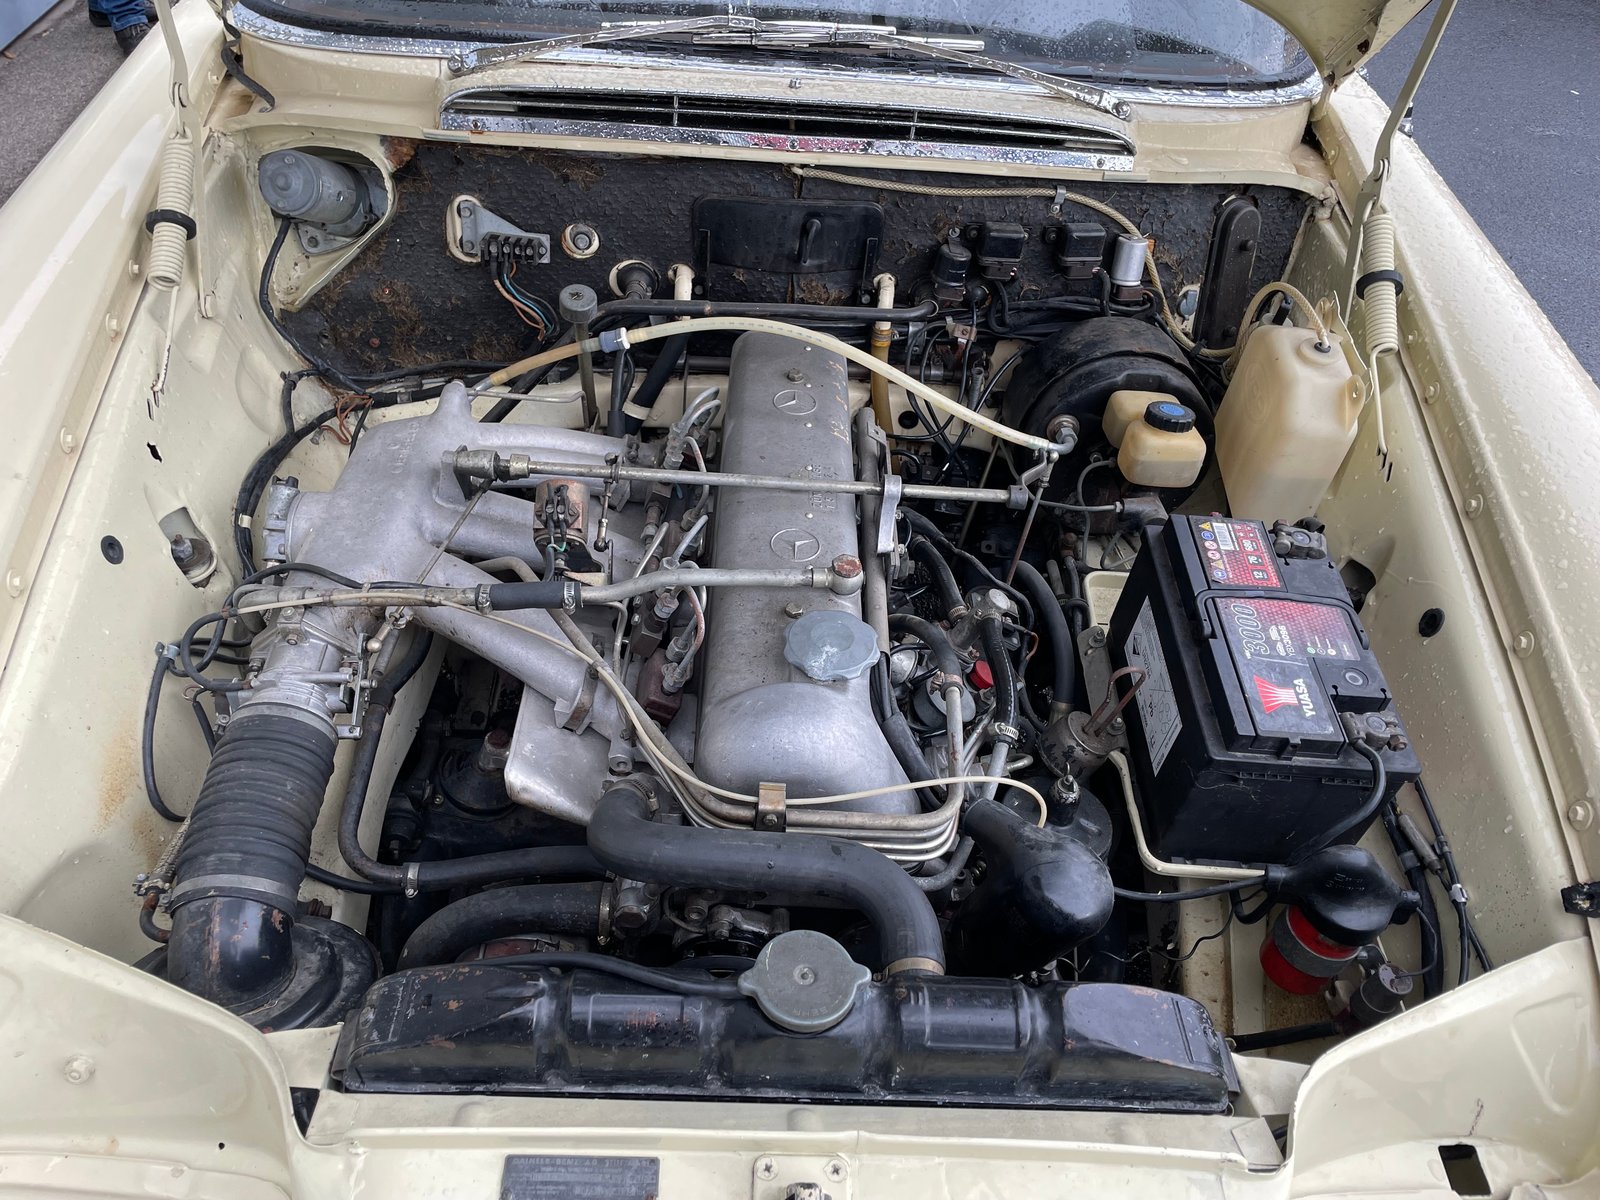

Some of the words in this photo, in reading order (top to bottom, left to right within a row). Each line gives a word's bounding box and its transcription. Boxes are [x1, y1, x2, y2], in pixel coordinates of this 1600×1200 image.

[1252, 570, 1264, 579] 12
[1231, 603, 1270, 654] 3000
[1277, 625, 1296, 657] YBX3096
[1293, 678, 1316, 718] YUASA
